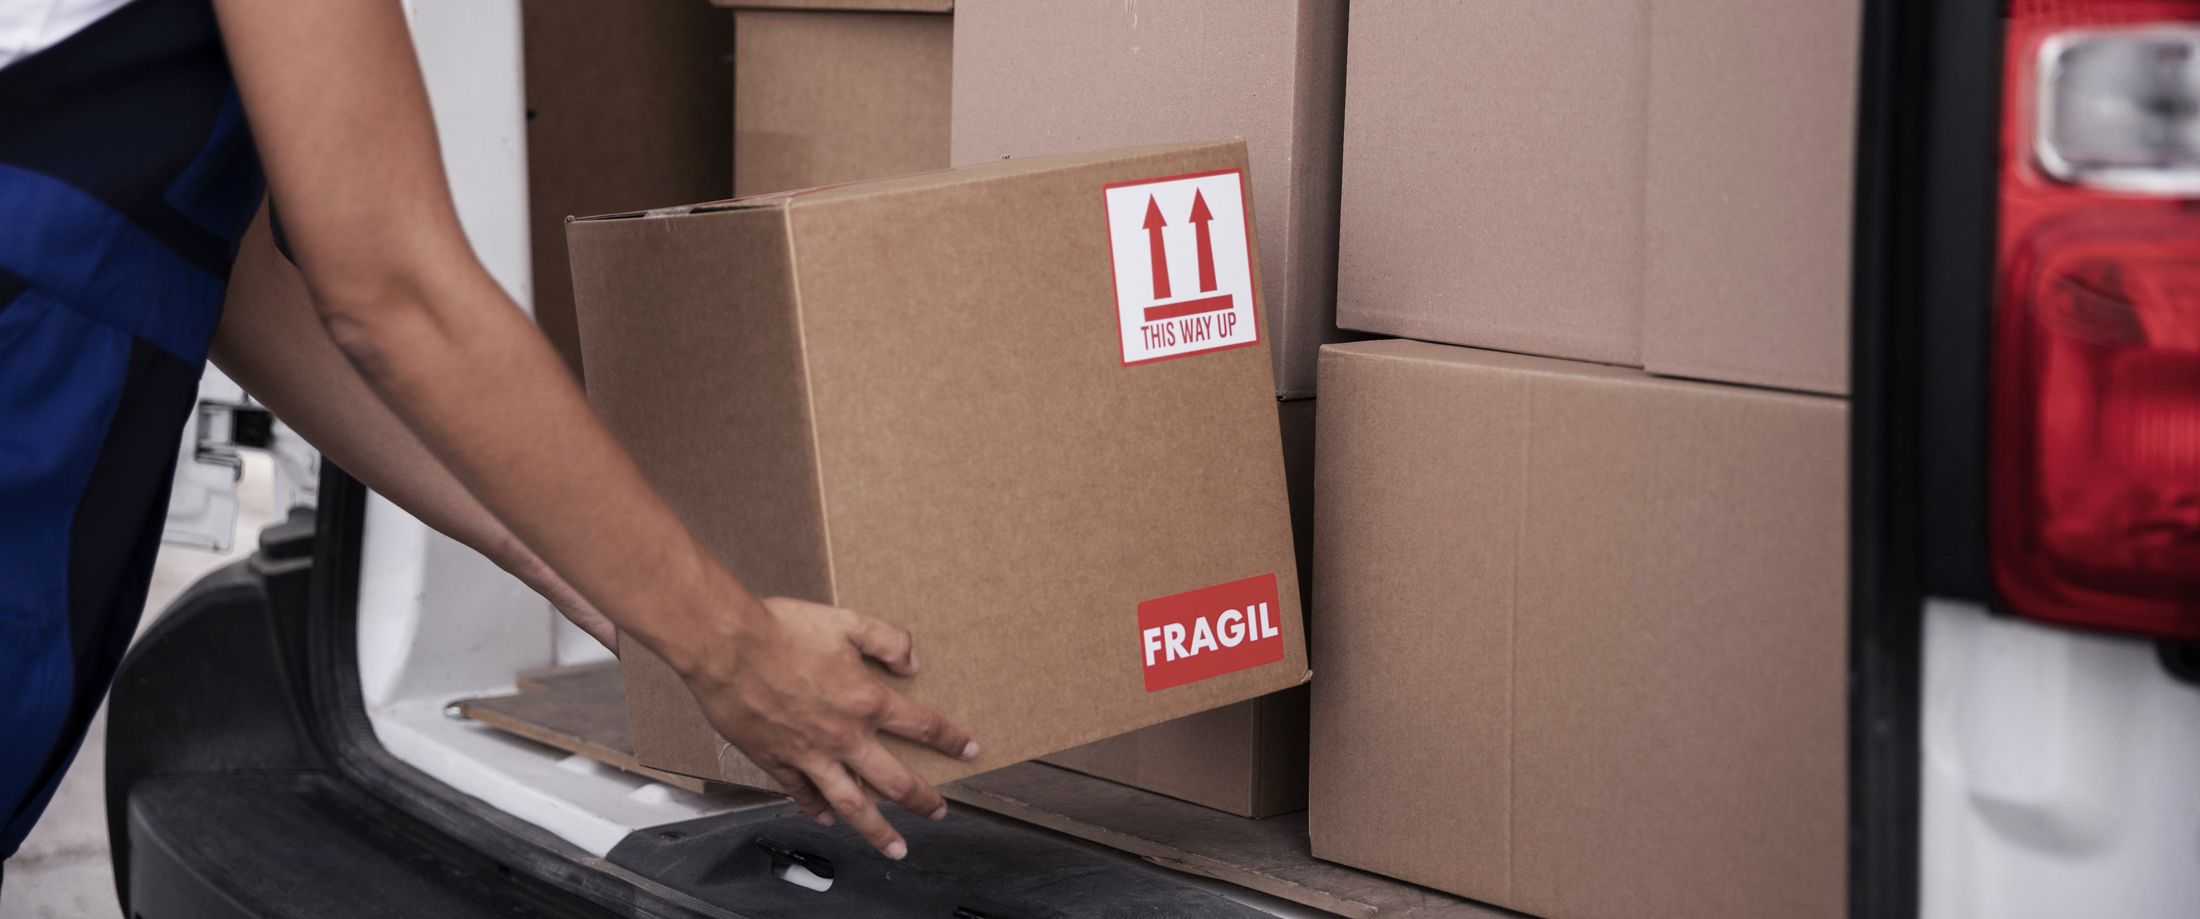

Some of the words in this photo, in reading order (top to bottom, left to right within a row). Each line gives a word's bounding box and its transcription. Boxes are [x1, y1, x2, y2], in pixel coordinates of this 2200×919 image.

[1141, 321, 1176, 350] THIS
[1179, 315, 1212, 344] WAY
[1217, 312, 1237, 339] UP
[1143, 602, 1279, 667] FRAGIL
